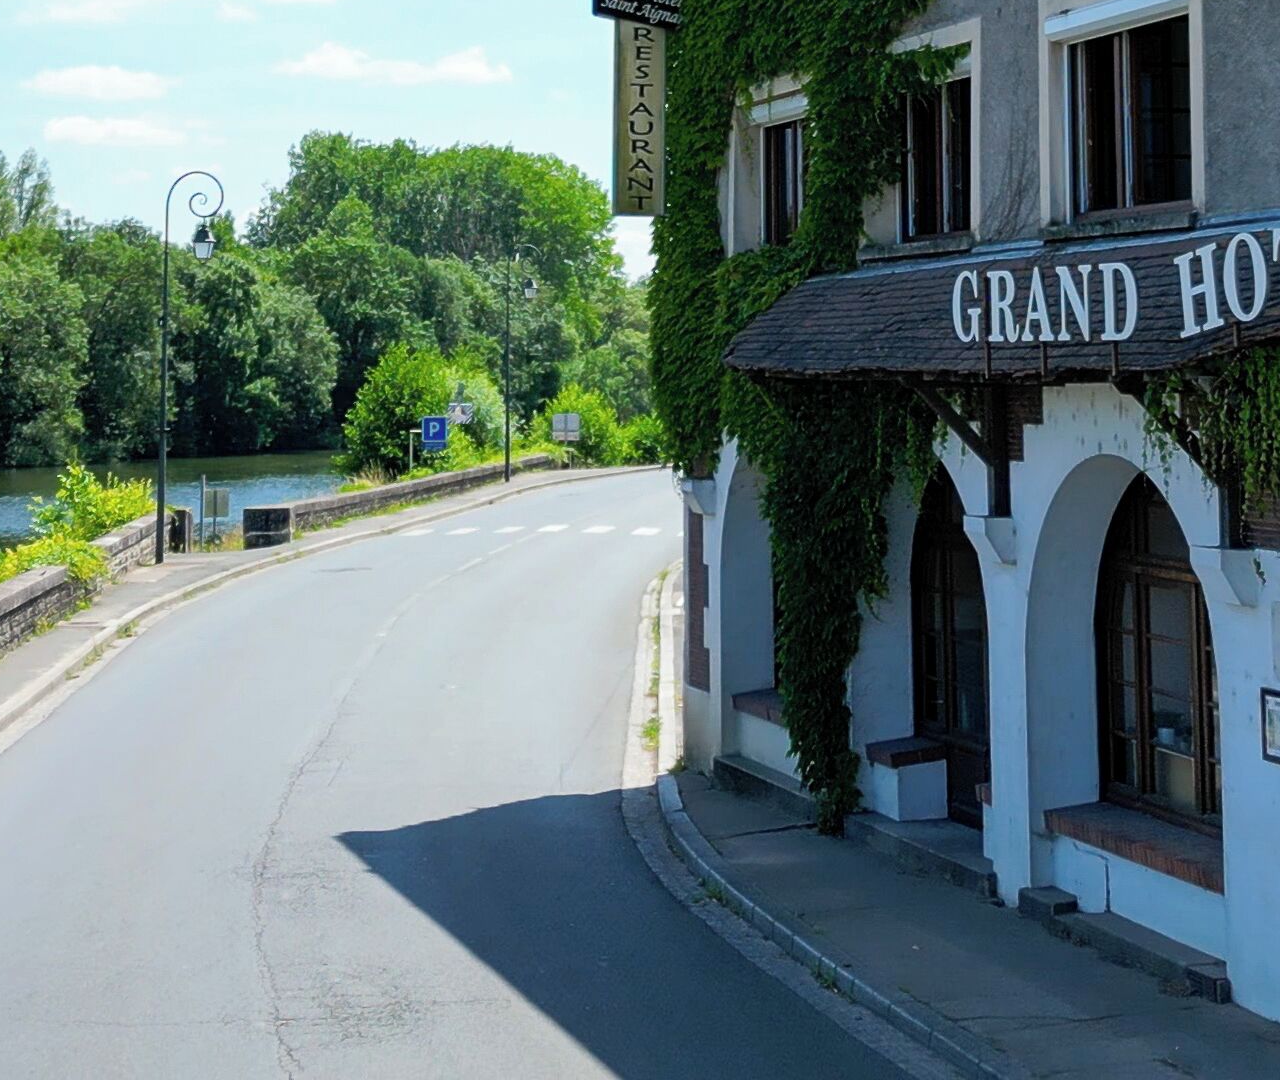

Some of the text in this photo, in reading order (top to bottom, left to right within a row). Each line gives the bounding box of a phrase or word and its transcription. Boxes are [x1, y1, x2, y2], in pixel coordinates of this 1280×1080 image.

[627, 26, 654, 211] RESTAURANT
[952, 262, 1138, 344] GRAND
[429, 421, 440, 437] P
